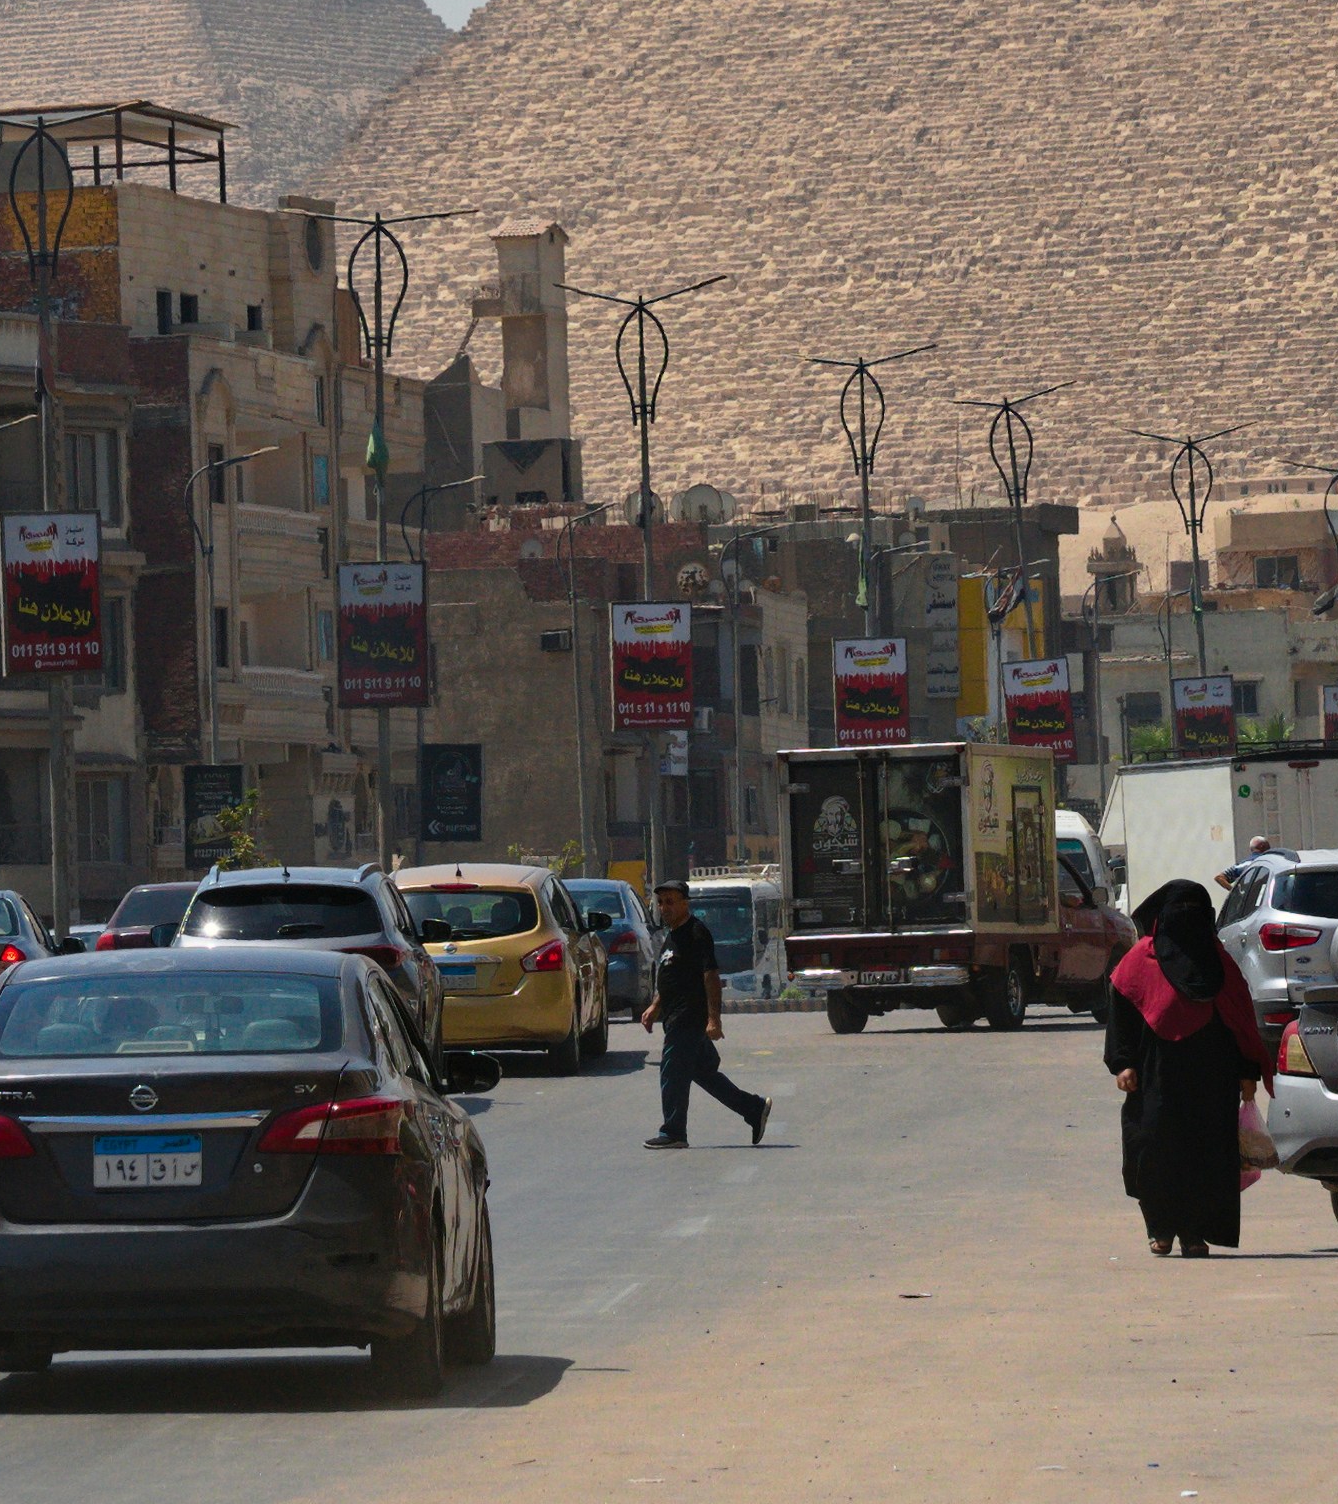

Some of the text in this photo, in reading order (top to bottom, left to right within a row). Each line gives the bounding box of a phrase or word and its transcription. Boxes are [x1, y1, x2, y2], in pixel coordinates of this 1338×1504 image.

[12, 641, 99, 657] 011 511 9 11 10
[344, 679, 361, 690] 011
[384, 677, 392, 690] 9
[395, 677, 405, 689] 11
[408, 676, 421, 688] 10
[618, 702, 634, 714] 011
[637, 705, 642, 713] 5
[645, 702, 655, 713] 11
[666, 702, 677, 713] 11
[679, 701, 690, 713] 10
[840, 729, 855, 740] 011
[863, 728, 873, 739] 11
[885, 728, 894, 738] 11
[896, 728, 906, 738] 10
[1064, 740, 1073, 749] 10
[294, 1084, 317, 1094] SV
[104, 1159, 141, 1182] ١٩٤
